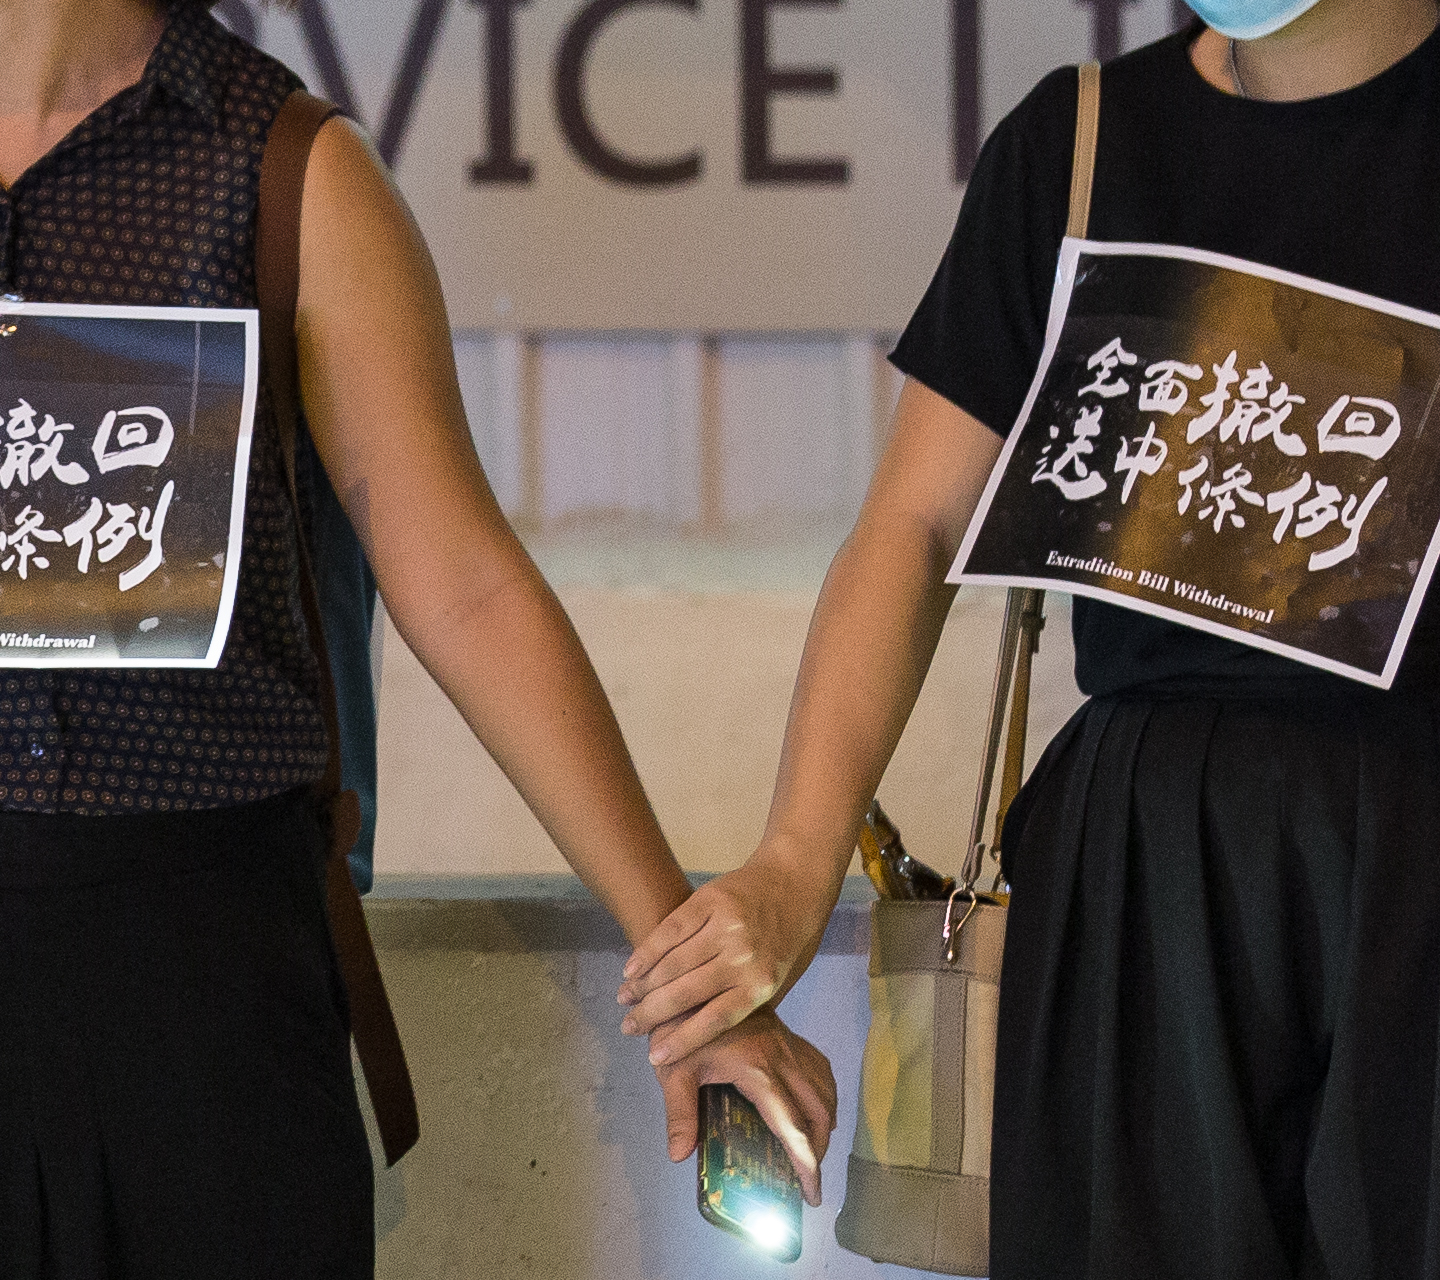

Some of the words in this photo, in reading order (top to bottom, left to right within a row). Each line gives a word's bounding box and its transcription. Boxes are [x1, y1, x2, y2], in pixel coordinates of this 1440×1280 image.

[1077, 336, 1402, 461] 全面撤回
[1030, 405, 1389, 572] 送中條例
[1045, 550, 1134, 582] Extradition
[1137, 568, 1169, 592] Bill
[1173, 578, 1275, 624] Withdrawal
